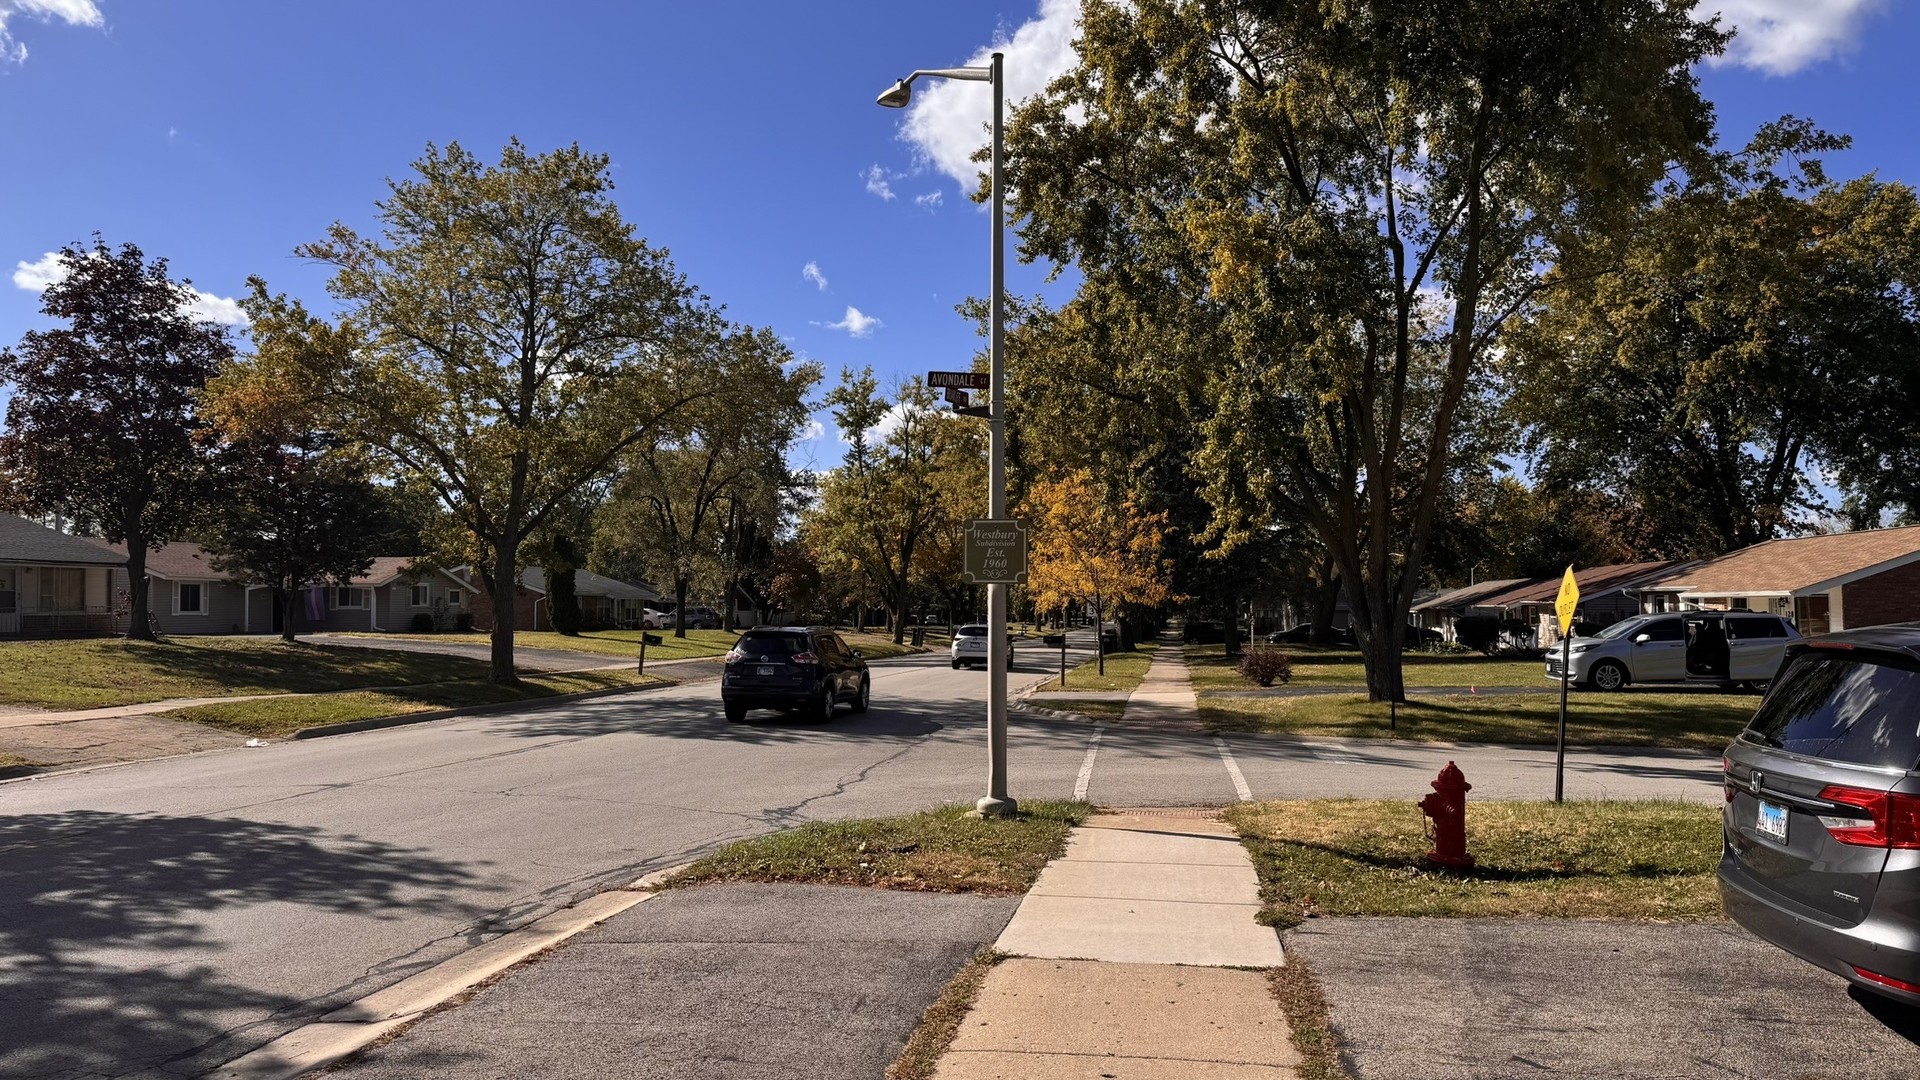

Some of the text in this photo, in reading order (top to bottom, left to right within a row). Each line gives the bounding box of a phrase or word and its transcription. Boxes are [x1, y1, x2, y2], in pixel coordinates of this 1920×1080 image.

[931, 373, 975, 386] AVONDALE
[973, 530, 1018, 541] Westbury
[987, 548, 1005, 557] Est.
[983, 559, 1008, 568] 1960
